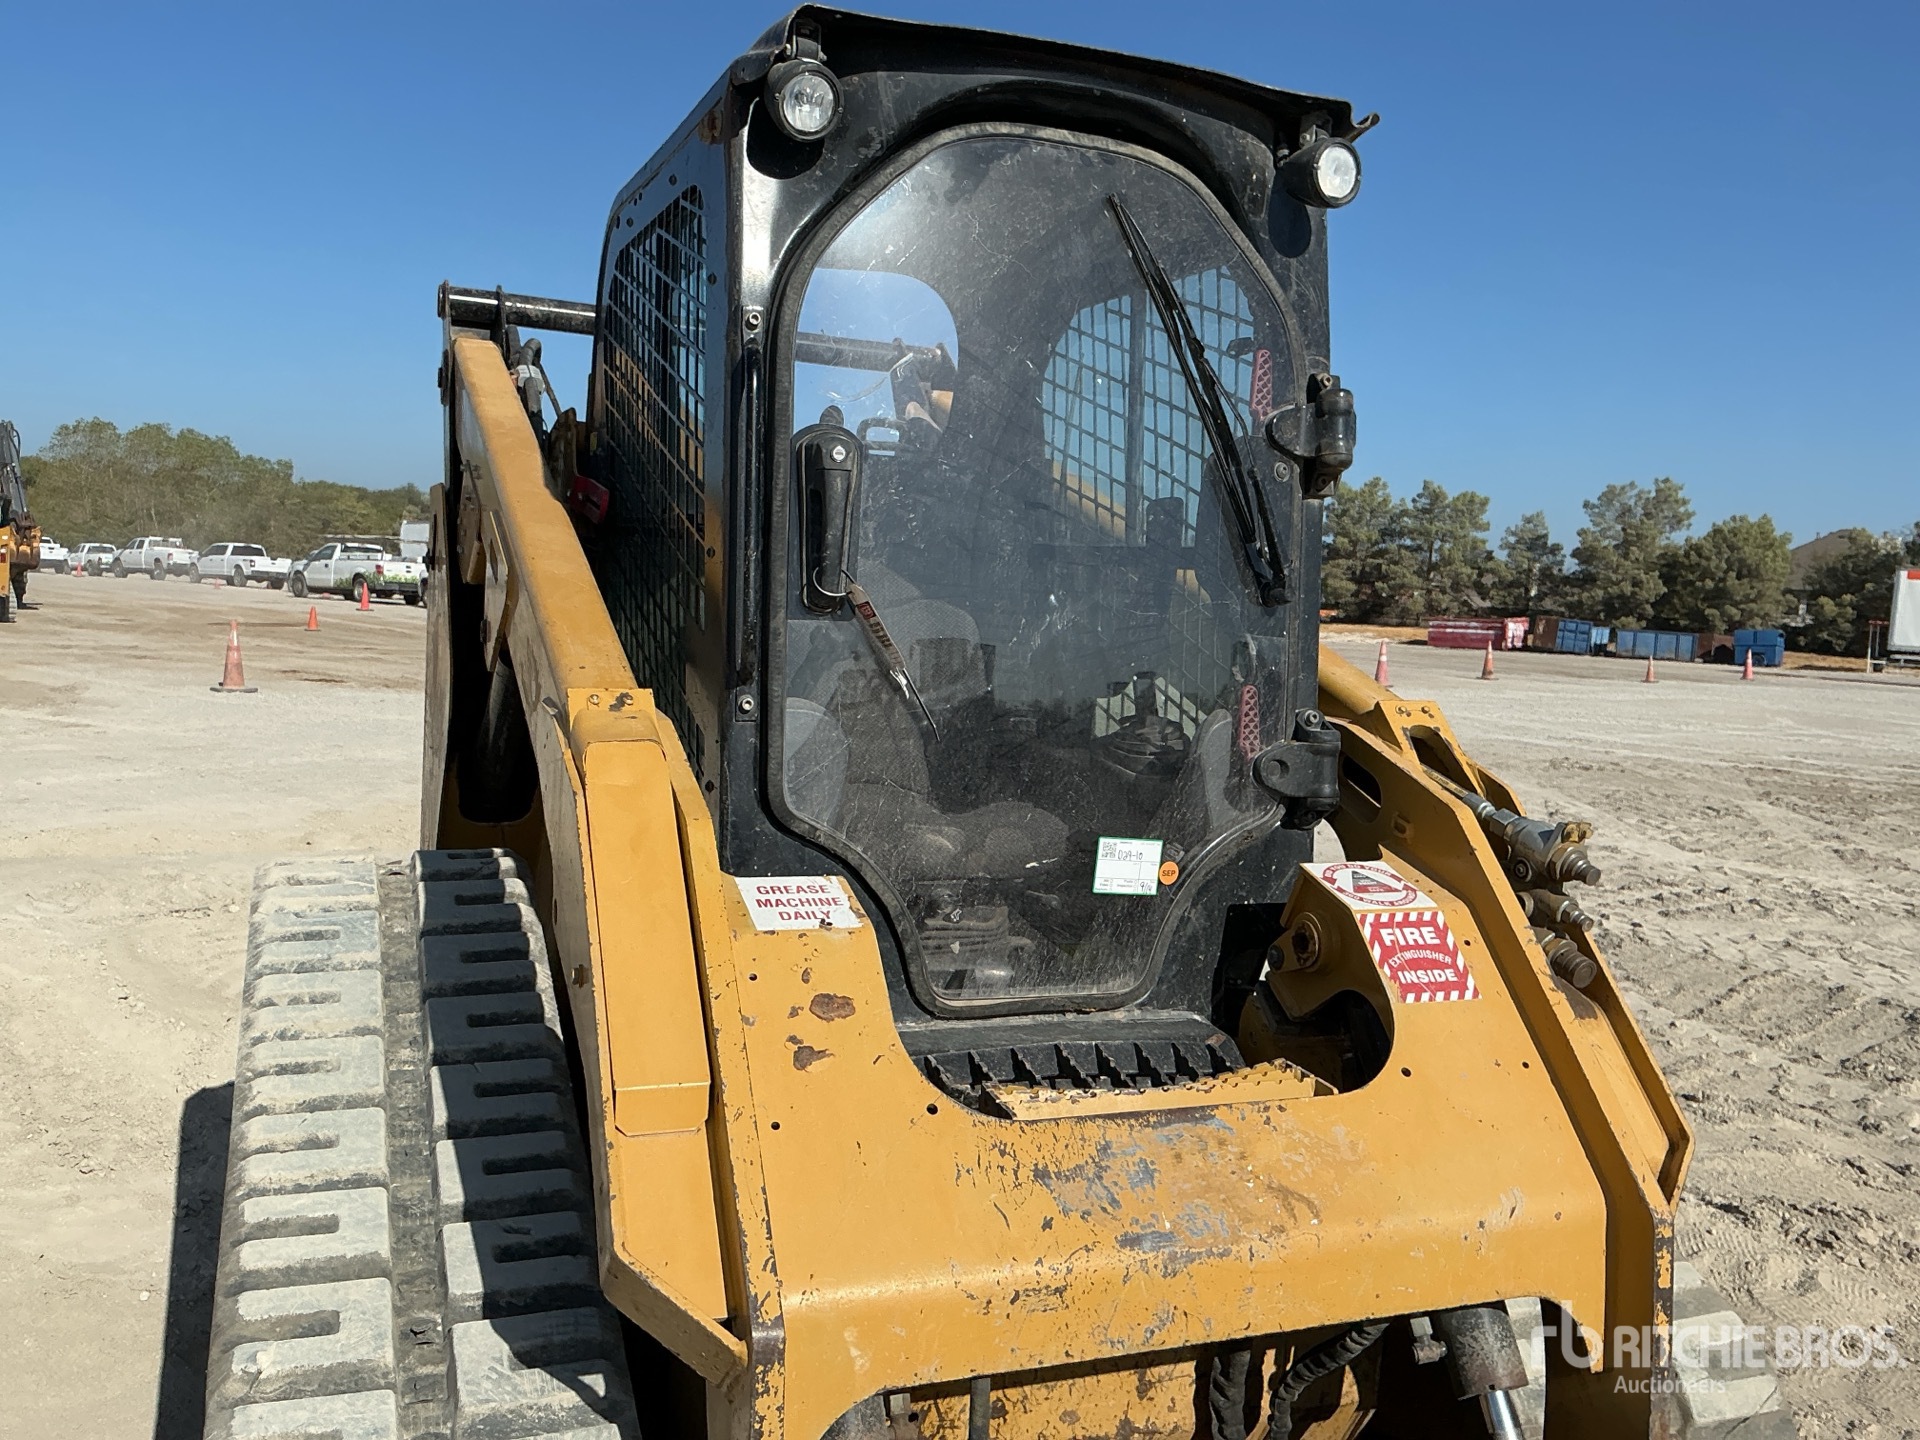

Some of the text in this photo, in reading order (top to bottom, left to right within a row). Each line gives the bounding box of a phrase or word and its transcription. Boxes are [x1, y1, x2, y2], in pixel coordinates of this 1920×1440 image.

[1161, 869, 1176, 877] SEP
[756, 884, 831, 895] GREASE
[755, 897, 844, 908] MACHINE
[778, 910, 831, 920] DAILY
[1379, 926, 1441, 947] FIRE
[1389, 949, 1453, 968] EXTINGUISHER
[1397, 968, 1459, 984] INSIDE
